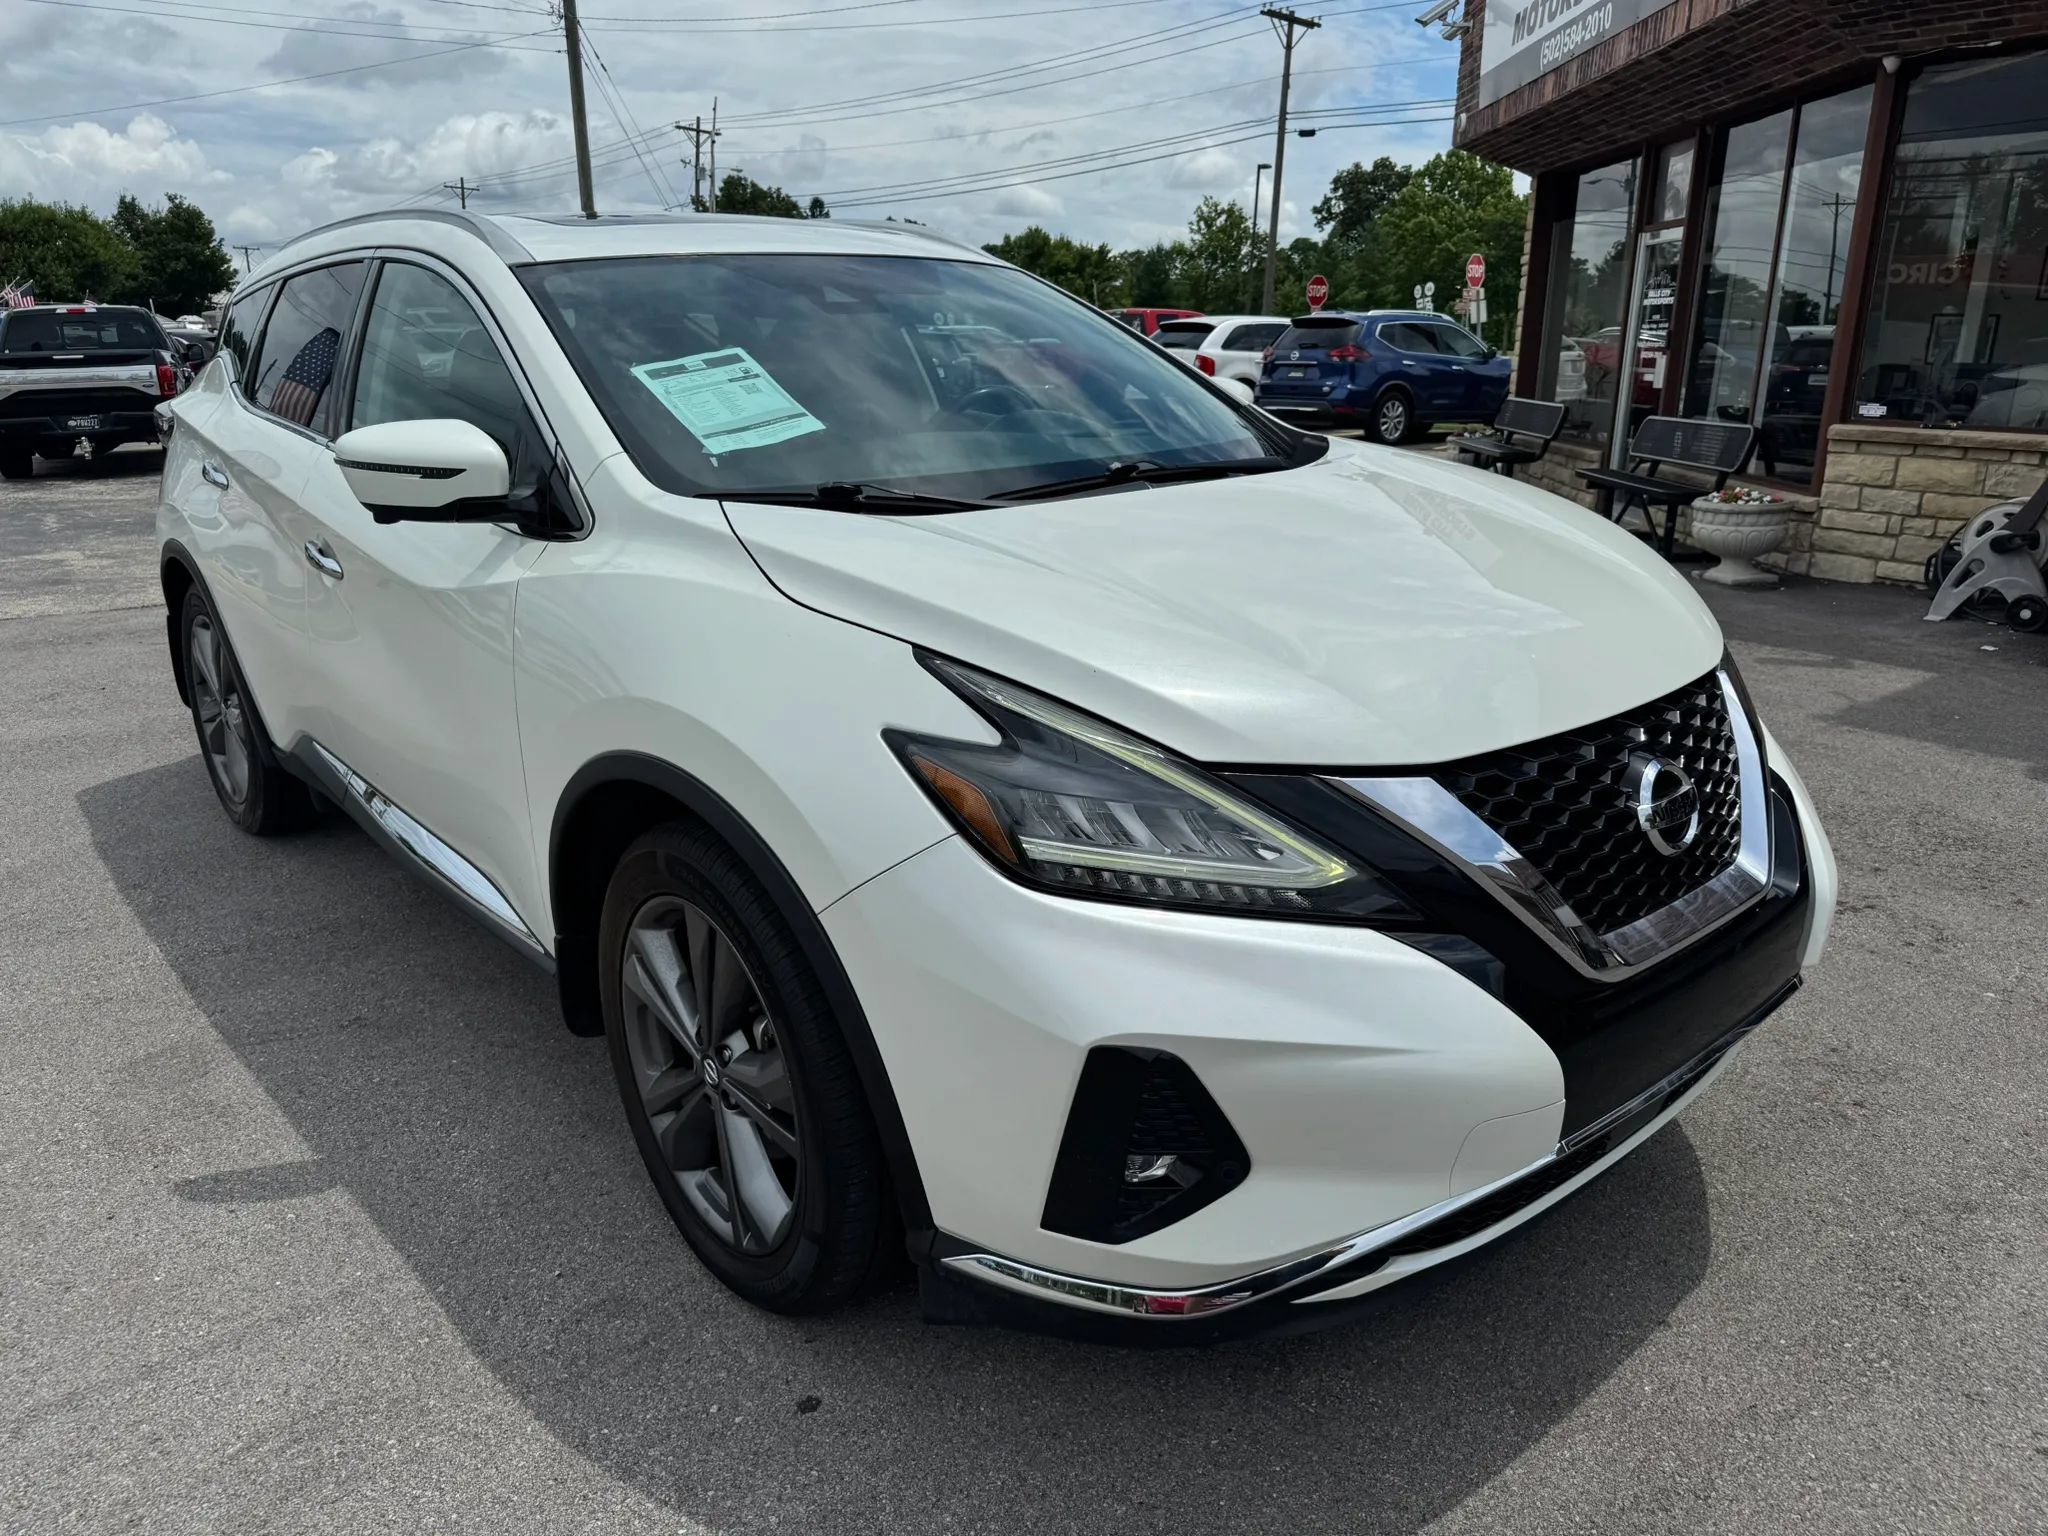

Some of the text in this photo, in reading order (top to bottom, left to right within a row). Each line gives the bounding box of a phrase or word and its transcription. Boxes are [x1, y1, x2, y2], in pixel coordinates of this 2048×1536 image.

[1512, 0, 1581, 46] MOTO
[1540, 2, 1612, 71] (502)584-2010
[1467, 264, 1483, 278] STOP
[1307, 285, 1326, 297] STOP
